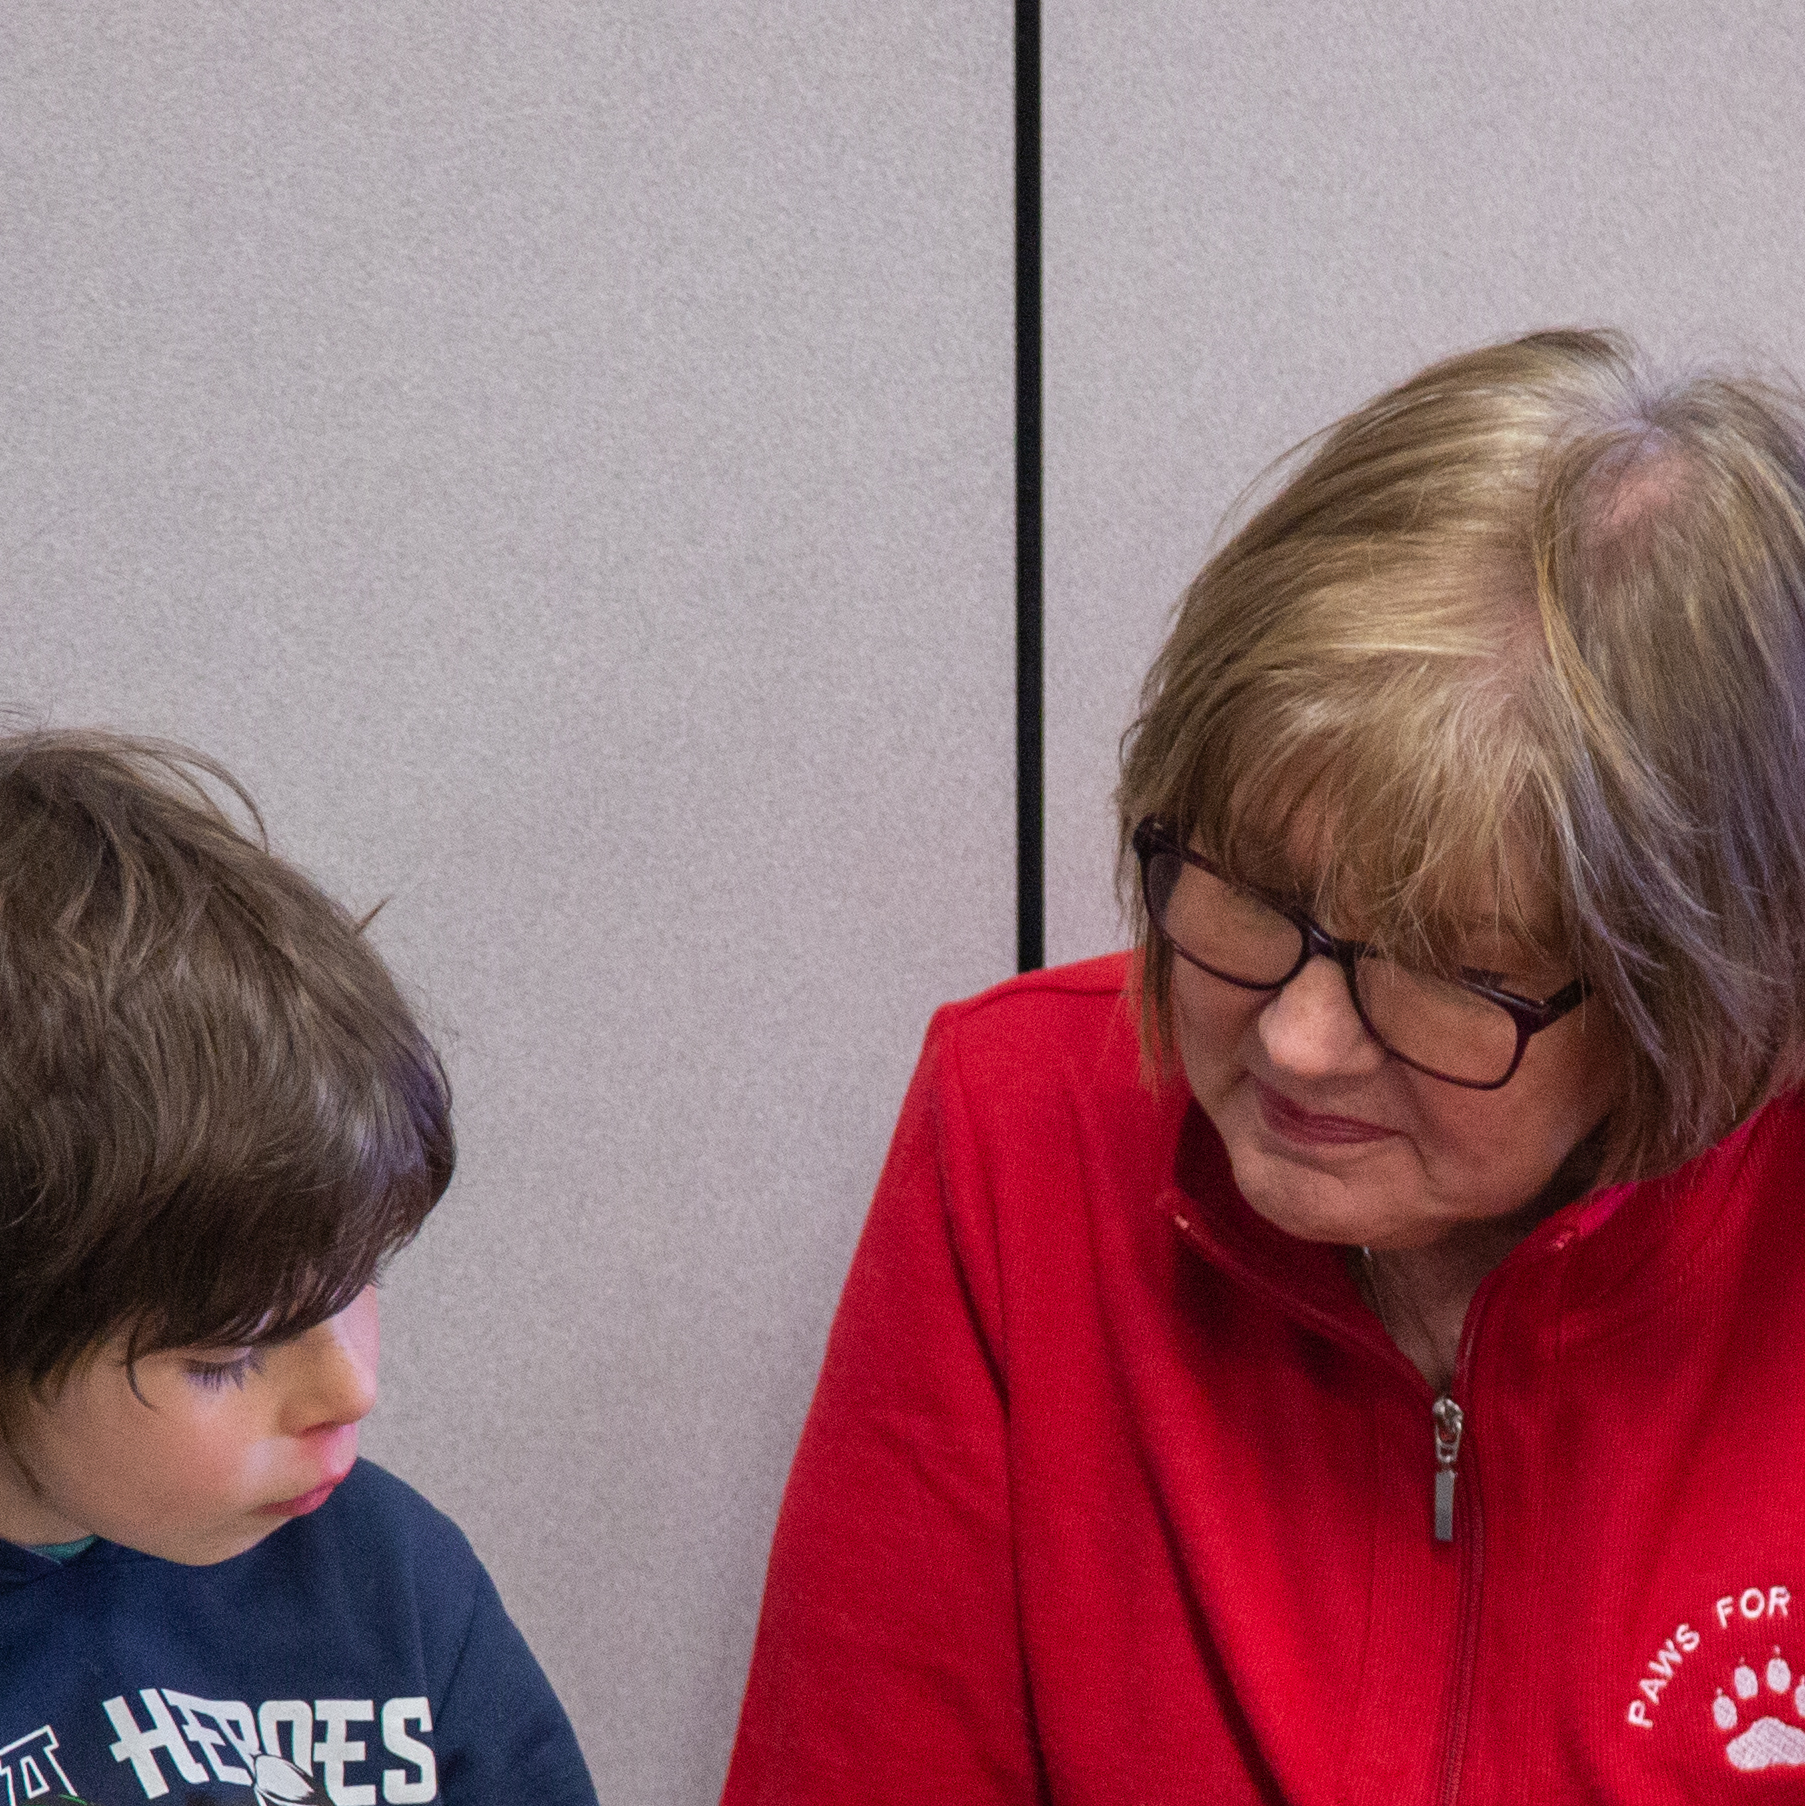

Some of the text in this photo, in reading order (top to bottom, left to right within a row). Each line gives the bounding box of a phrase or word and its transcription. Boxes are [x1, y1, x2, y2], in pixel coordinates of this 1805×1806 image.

[1626, 1621, 1701, 1729] PAWS
[1715, 1584, 1792, 1629] FOR
[99, 1686, 438, 1806] HEROES
